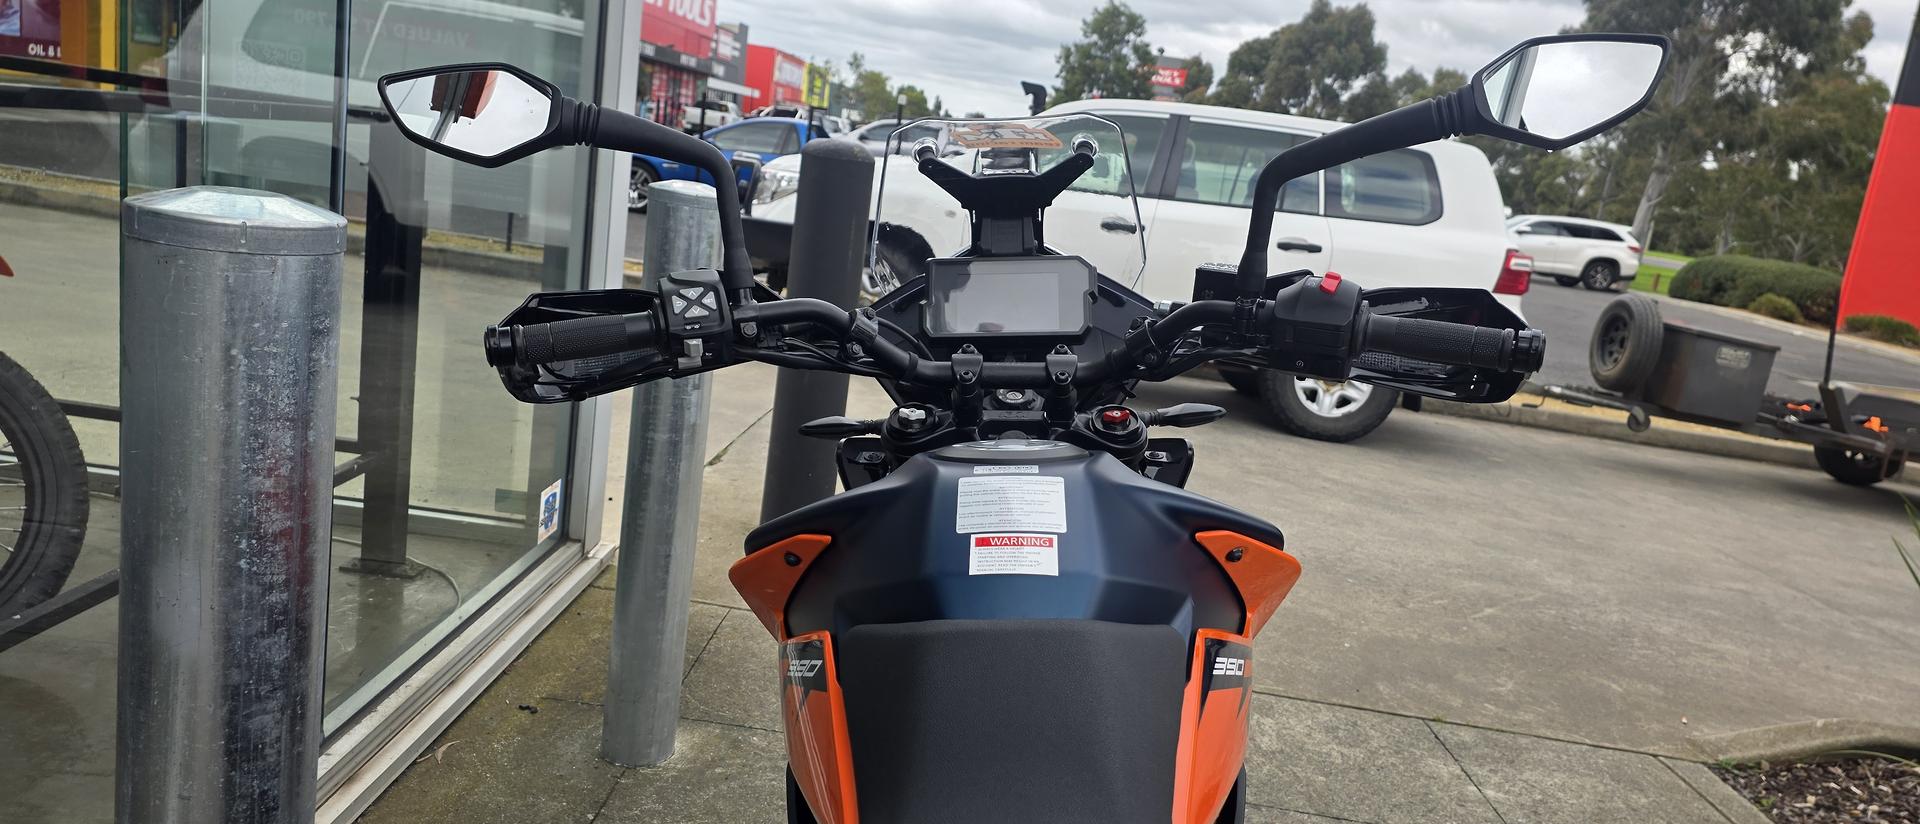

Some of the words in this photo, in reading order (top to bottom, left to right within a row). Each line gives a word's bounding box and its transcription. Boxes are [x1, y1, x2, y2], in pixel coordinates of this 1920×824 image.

[28, 43, 46, 56] OIL
[989, 537, 1050, 546] WARNING
[787, 660, 823, 677] 390
[1212, 657, 1245, 676] 390
